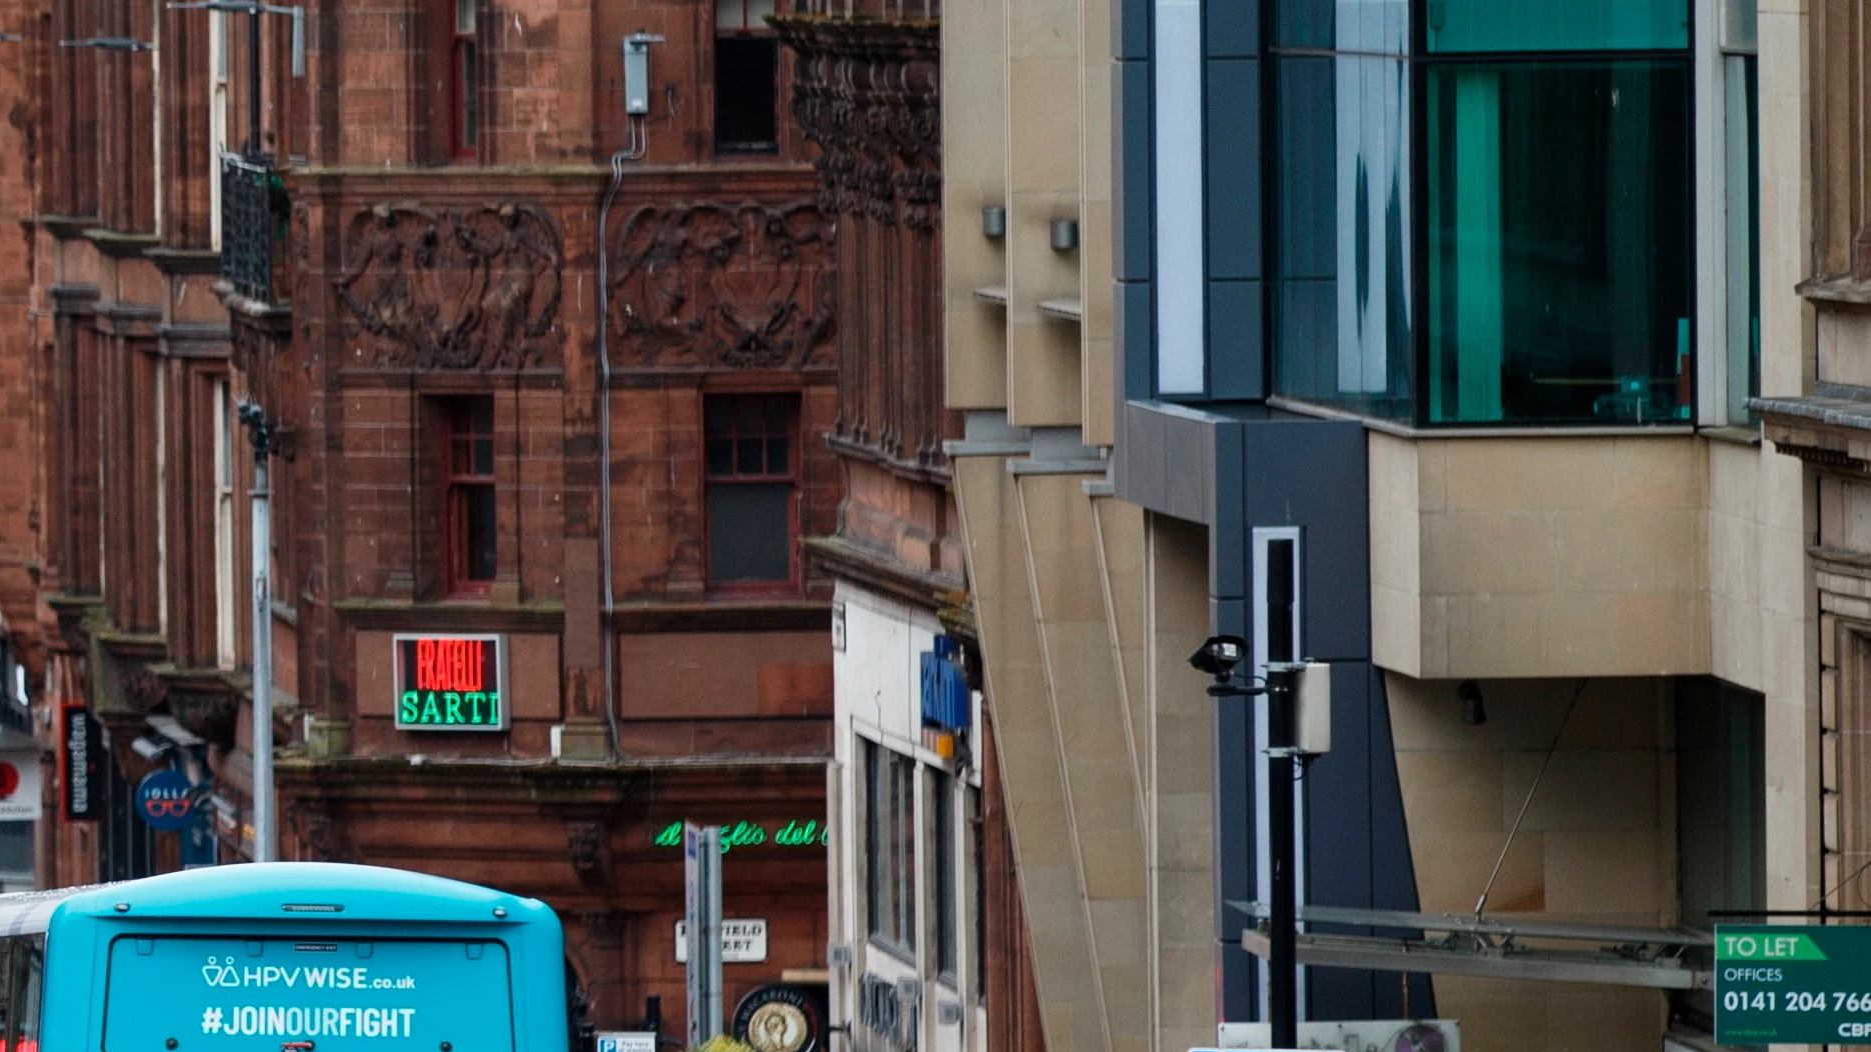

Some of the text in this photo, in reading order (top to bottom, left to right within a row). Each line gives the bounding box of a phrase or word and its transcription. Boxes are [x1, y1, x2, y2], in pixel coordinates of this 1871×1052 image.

[416, 638, 482, 691] FRATELLI
[401, 690, 499, 725] SARTI
[68, 713, 88, 813] wagamama
[721, 820, 768, 854] glio
[1724, 937, 1799, 957] TO LET
[1724, 967, 1783, 982] OFFICES
[1724, 991, 1776, 1012] 0141
[1785, 991, 1827, 1012] 204
[201, 1005, 416, 1037] #JOINOURFIGHT
